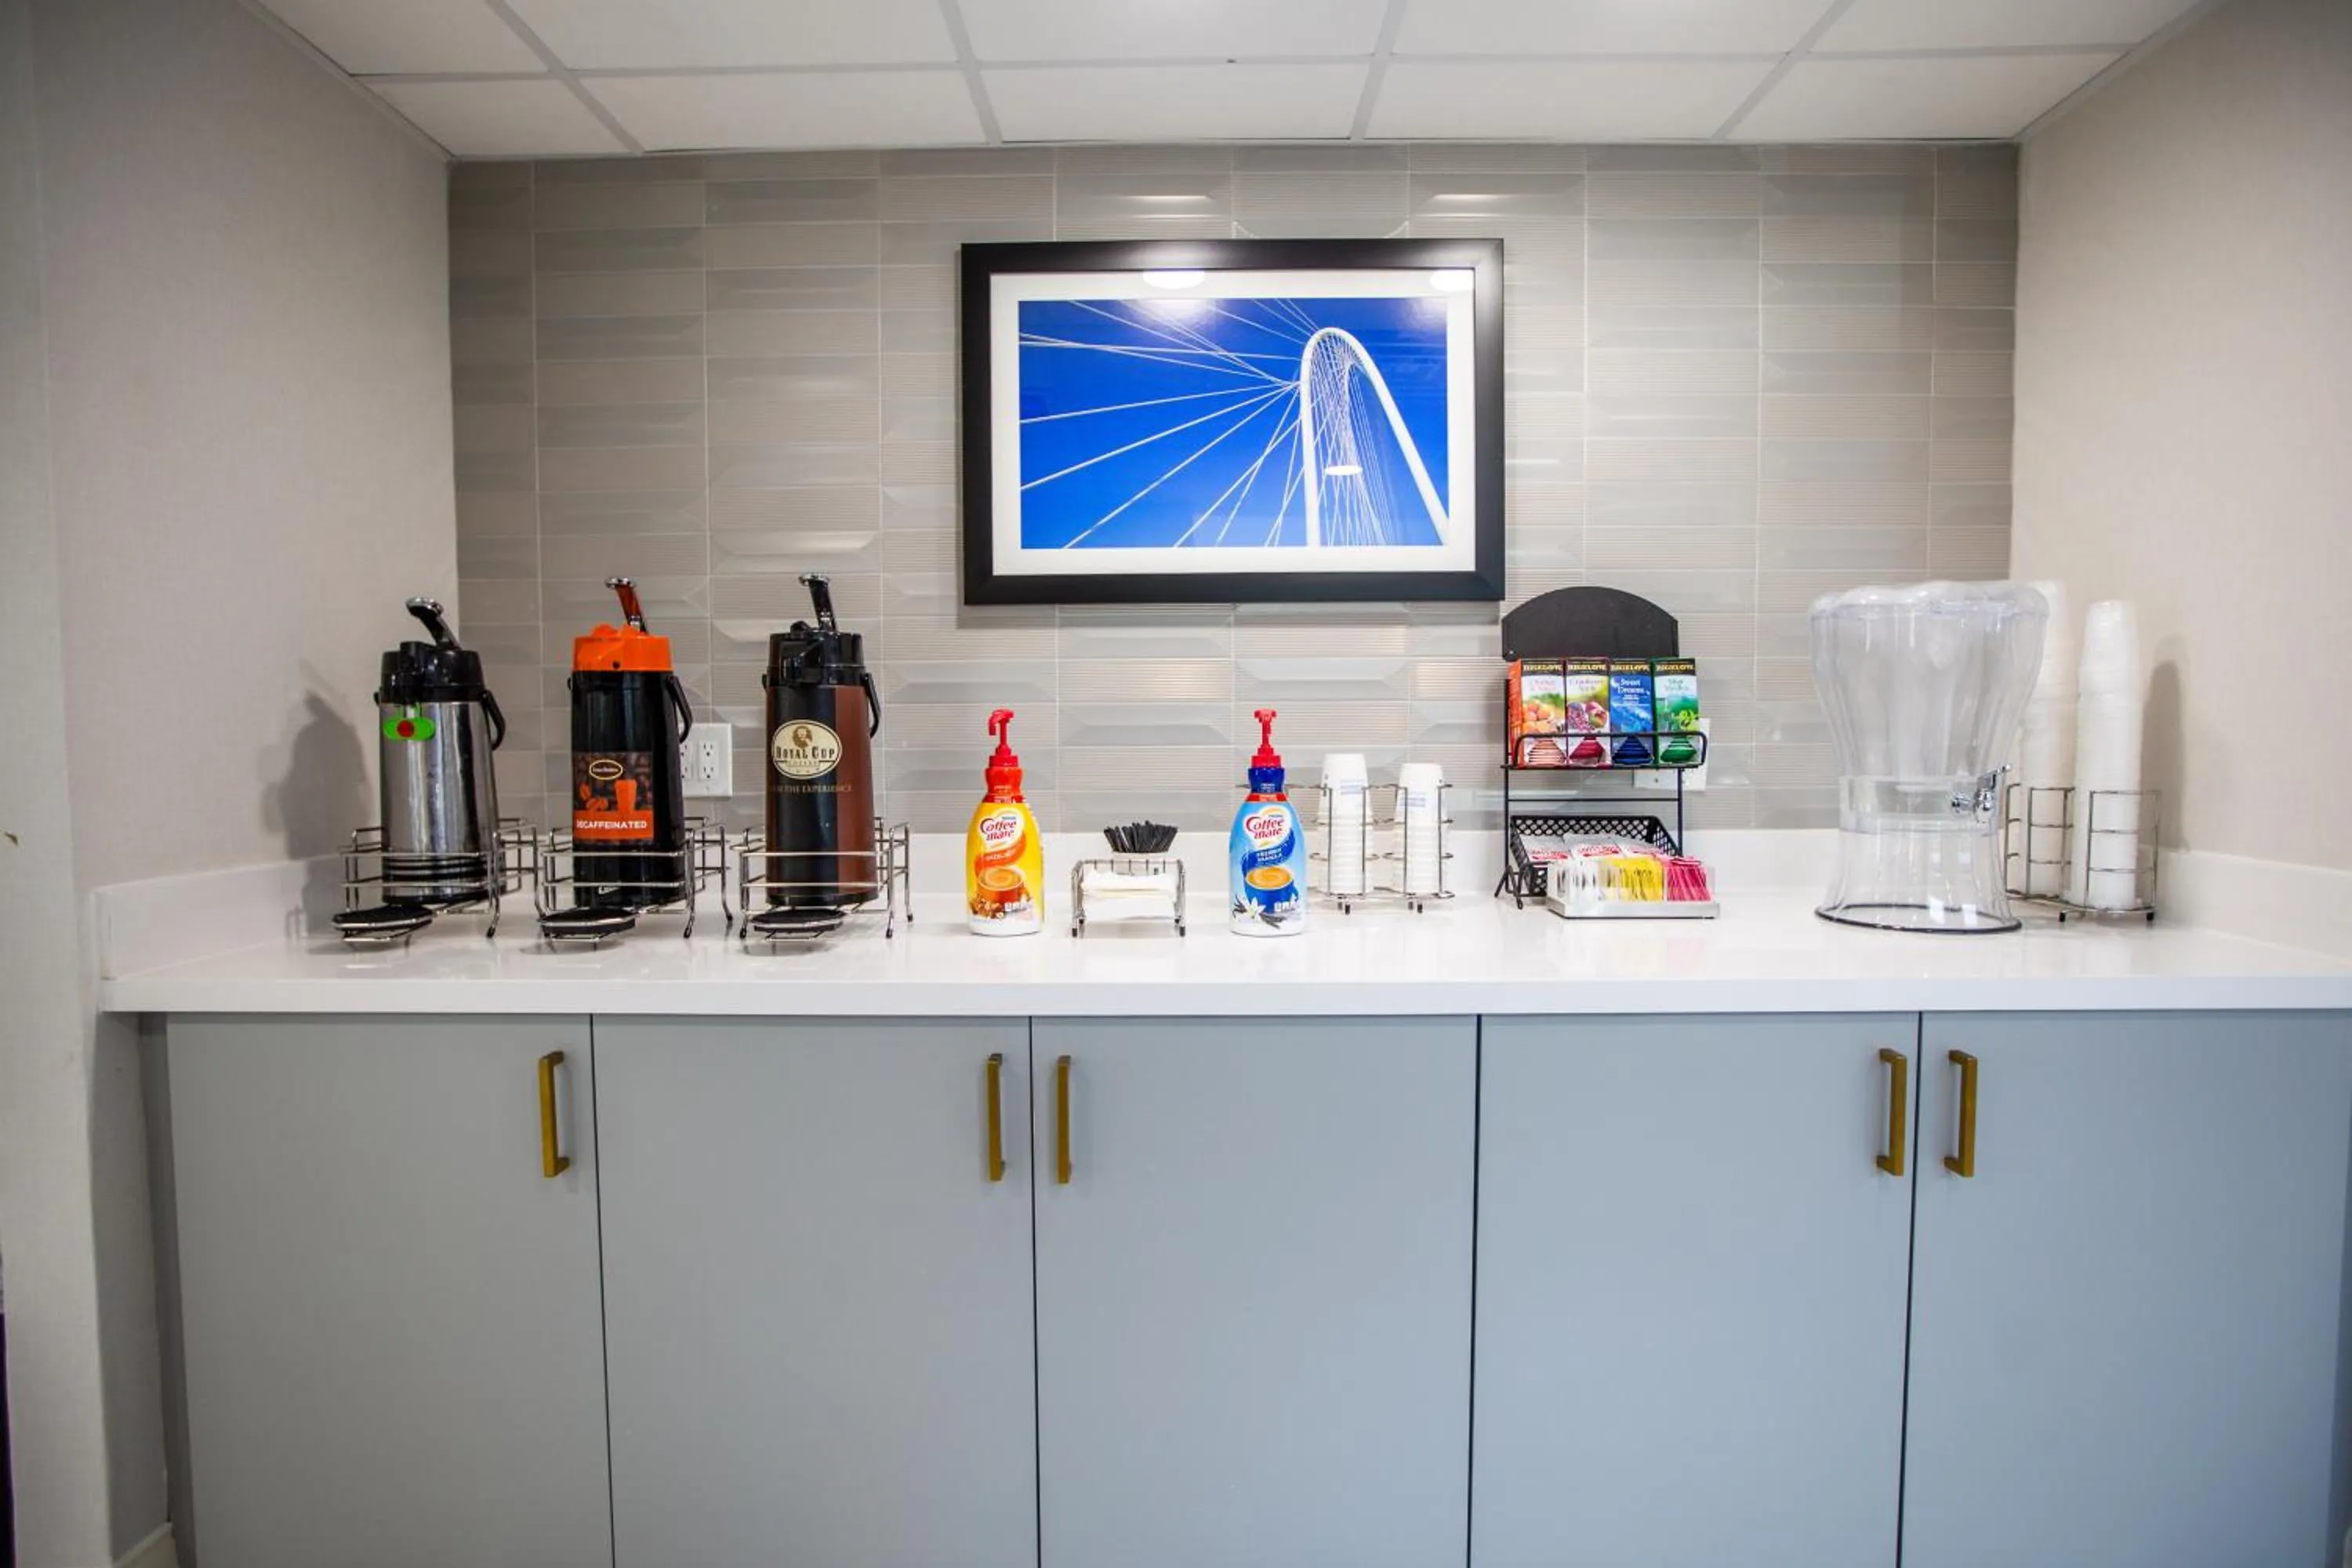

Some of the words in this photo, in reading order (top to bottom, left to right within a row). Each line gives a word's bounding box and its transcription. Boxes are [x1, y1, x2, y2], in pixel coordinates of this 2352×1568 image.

[811, 746, 835, 759] CUP
[980, 818, 1017, 834] Coffee
[1246, 816, 1284, 833] Coffee
[1254, 827, 1283, 840] mate
